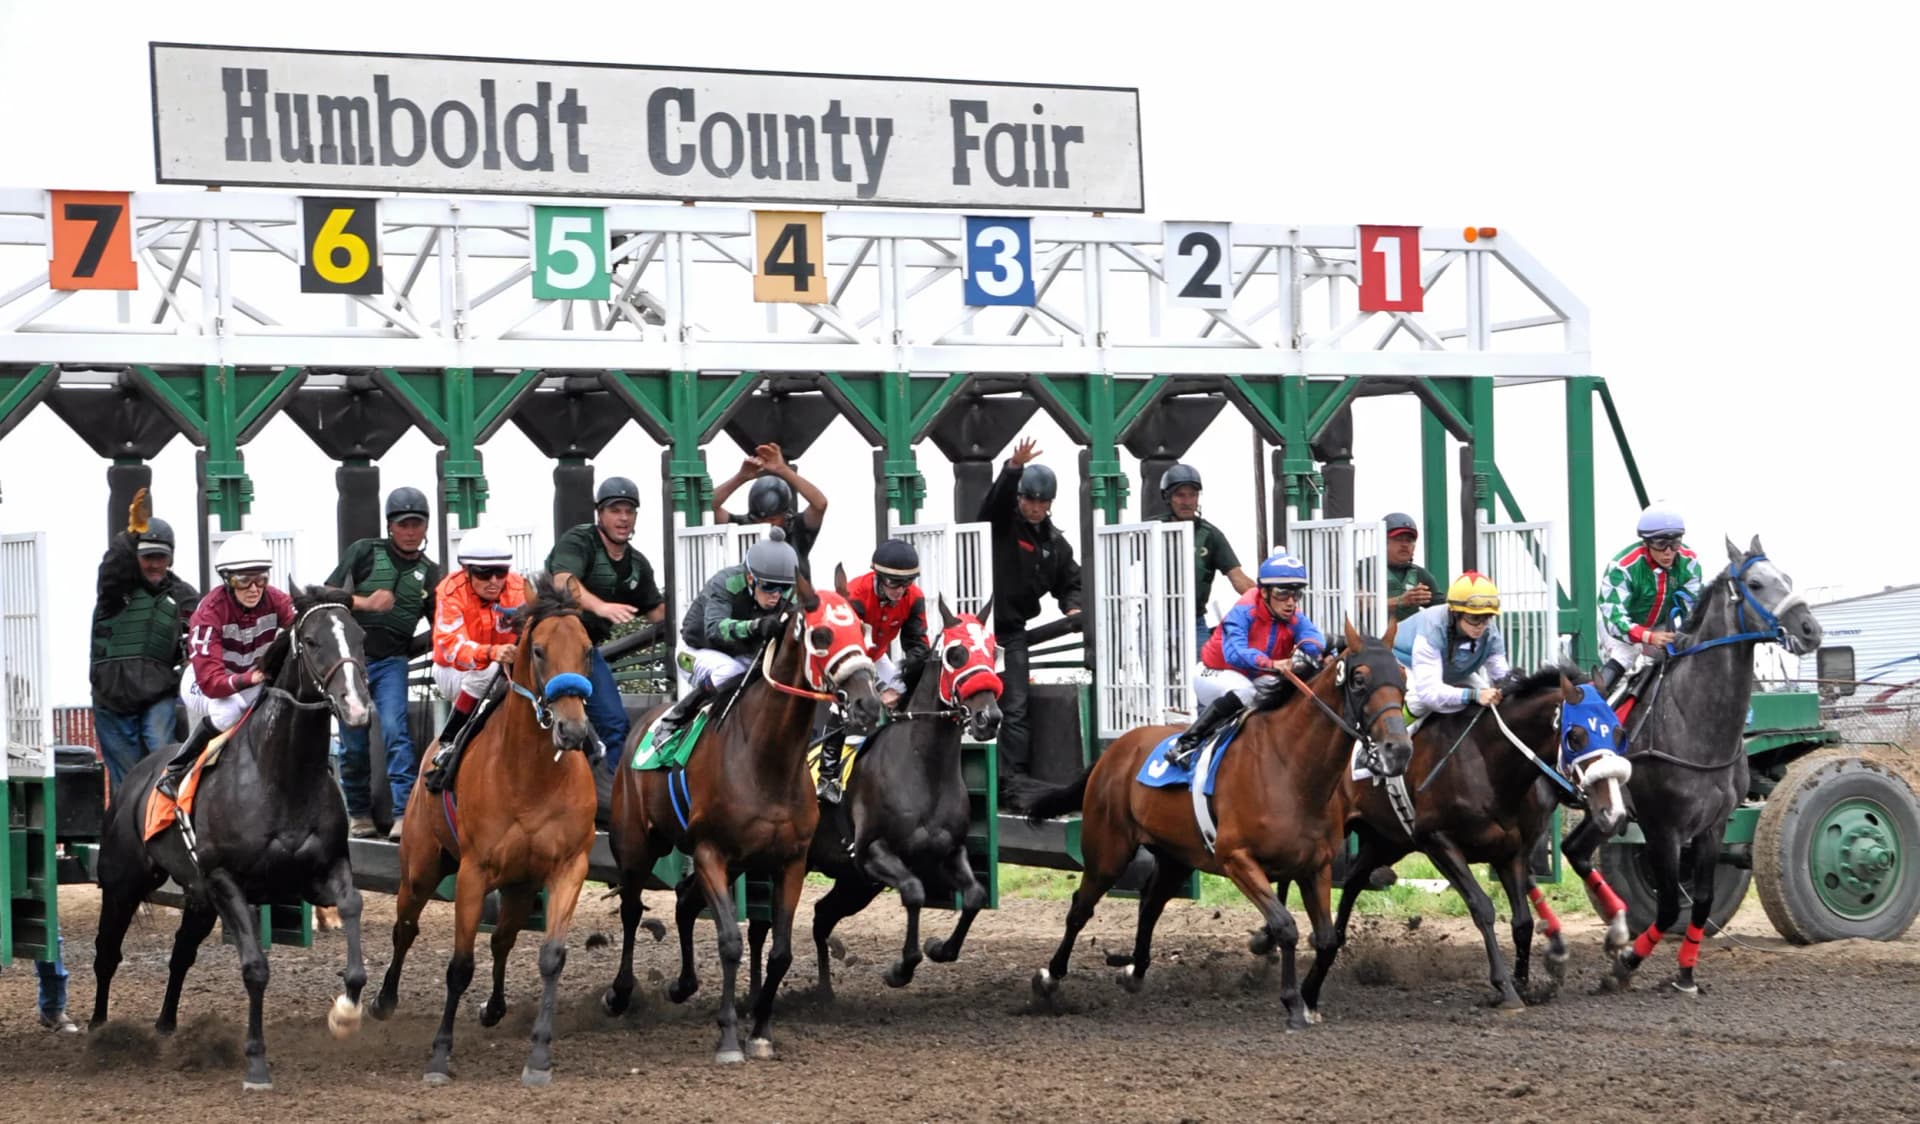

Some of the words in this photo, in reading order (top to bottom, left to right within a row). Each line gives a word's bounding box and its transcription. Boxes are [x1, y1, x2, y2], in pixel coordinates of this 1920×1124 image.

[221, 67, 590, 174] Humboldt
[646, 86, 894, 199] County
[949, 98, 1085, 189] Fair
[65, 204, 123, 278] 7
[312, 208, 371, 284] 6
[545, 216, 597, 289] 5
[763, 223, 816, 292] 4
[975, 226, 1025, 297] 3
[1177, 231, 1223, 299] 2
[1371, 236, 1403, 302] 1
